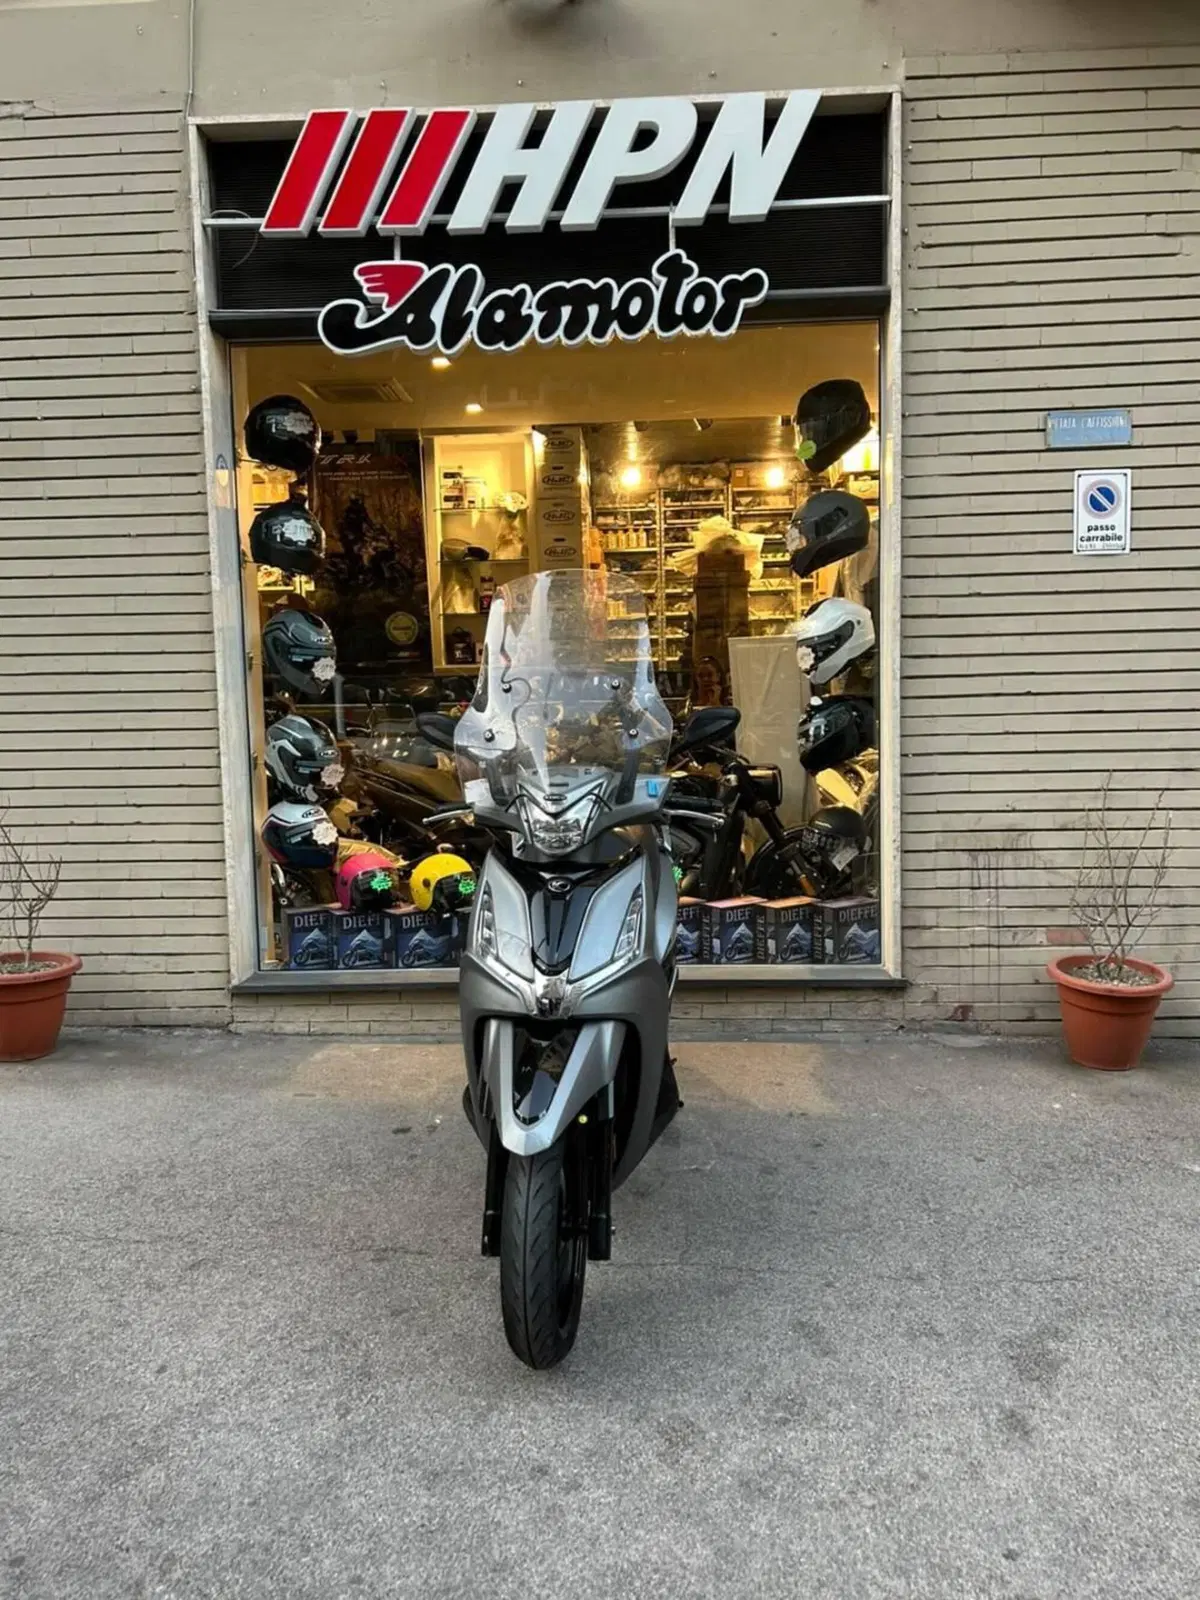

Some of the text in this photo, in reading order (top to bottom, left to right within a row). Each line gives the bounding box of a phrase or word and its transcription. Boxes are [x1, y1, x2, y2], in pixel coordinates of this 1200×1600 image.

[447, 89, 821, 235] HPN
[318, 248, 769, 356] Alamotor
[1087, 524, 1116, 533] passo
[1080, 533, 1123, 542] carrabile
[294, 914, 327, 928] DIEF
[726, 908, 753, 922] DIEF
